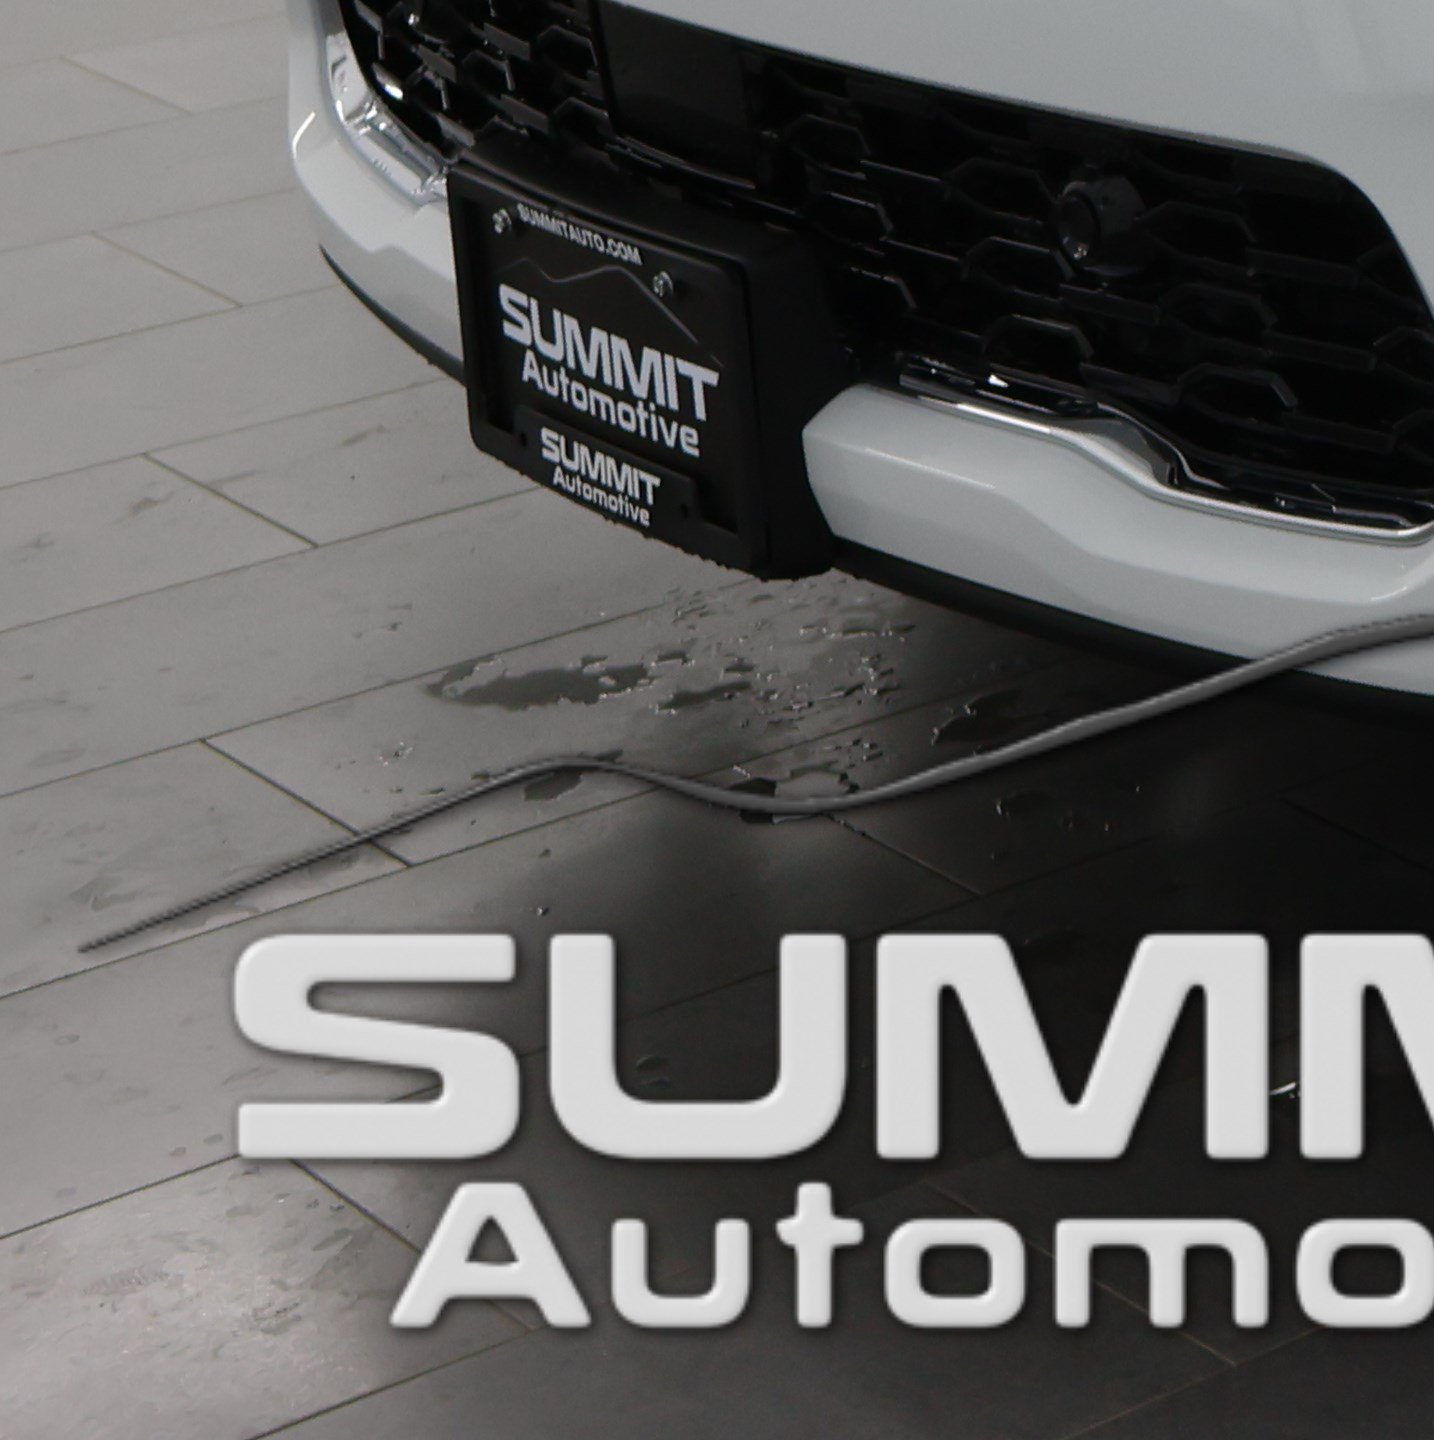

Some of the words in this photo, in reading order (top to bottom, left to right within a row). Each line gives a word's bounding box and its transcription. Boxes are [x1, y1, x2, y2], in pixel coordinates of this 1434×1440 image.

[516, 202, 643, 266] SUMMITAUTO.COM
[499, 283, 719, 421] SUMMIT
[522, 349, 700, 457] Automotive
[541, 426, 661, 506] SUMMIT
[553, 465, 650, 526] Automotive
